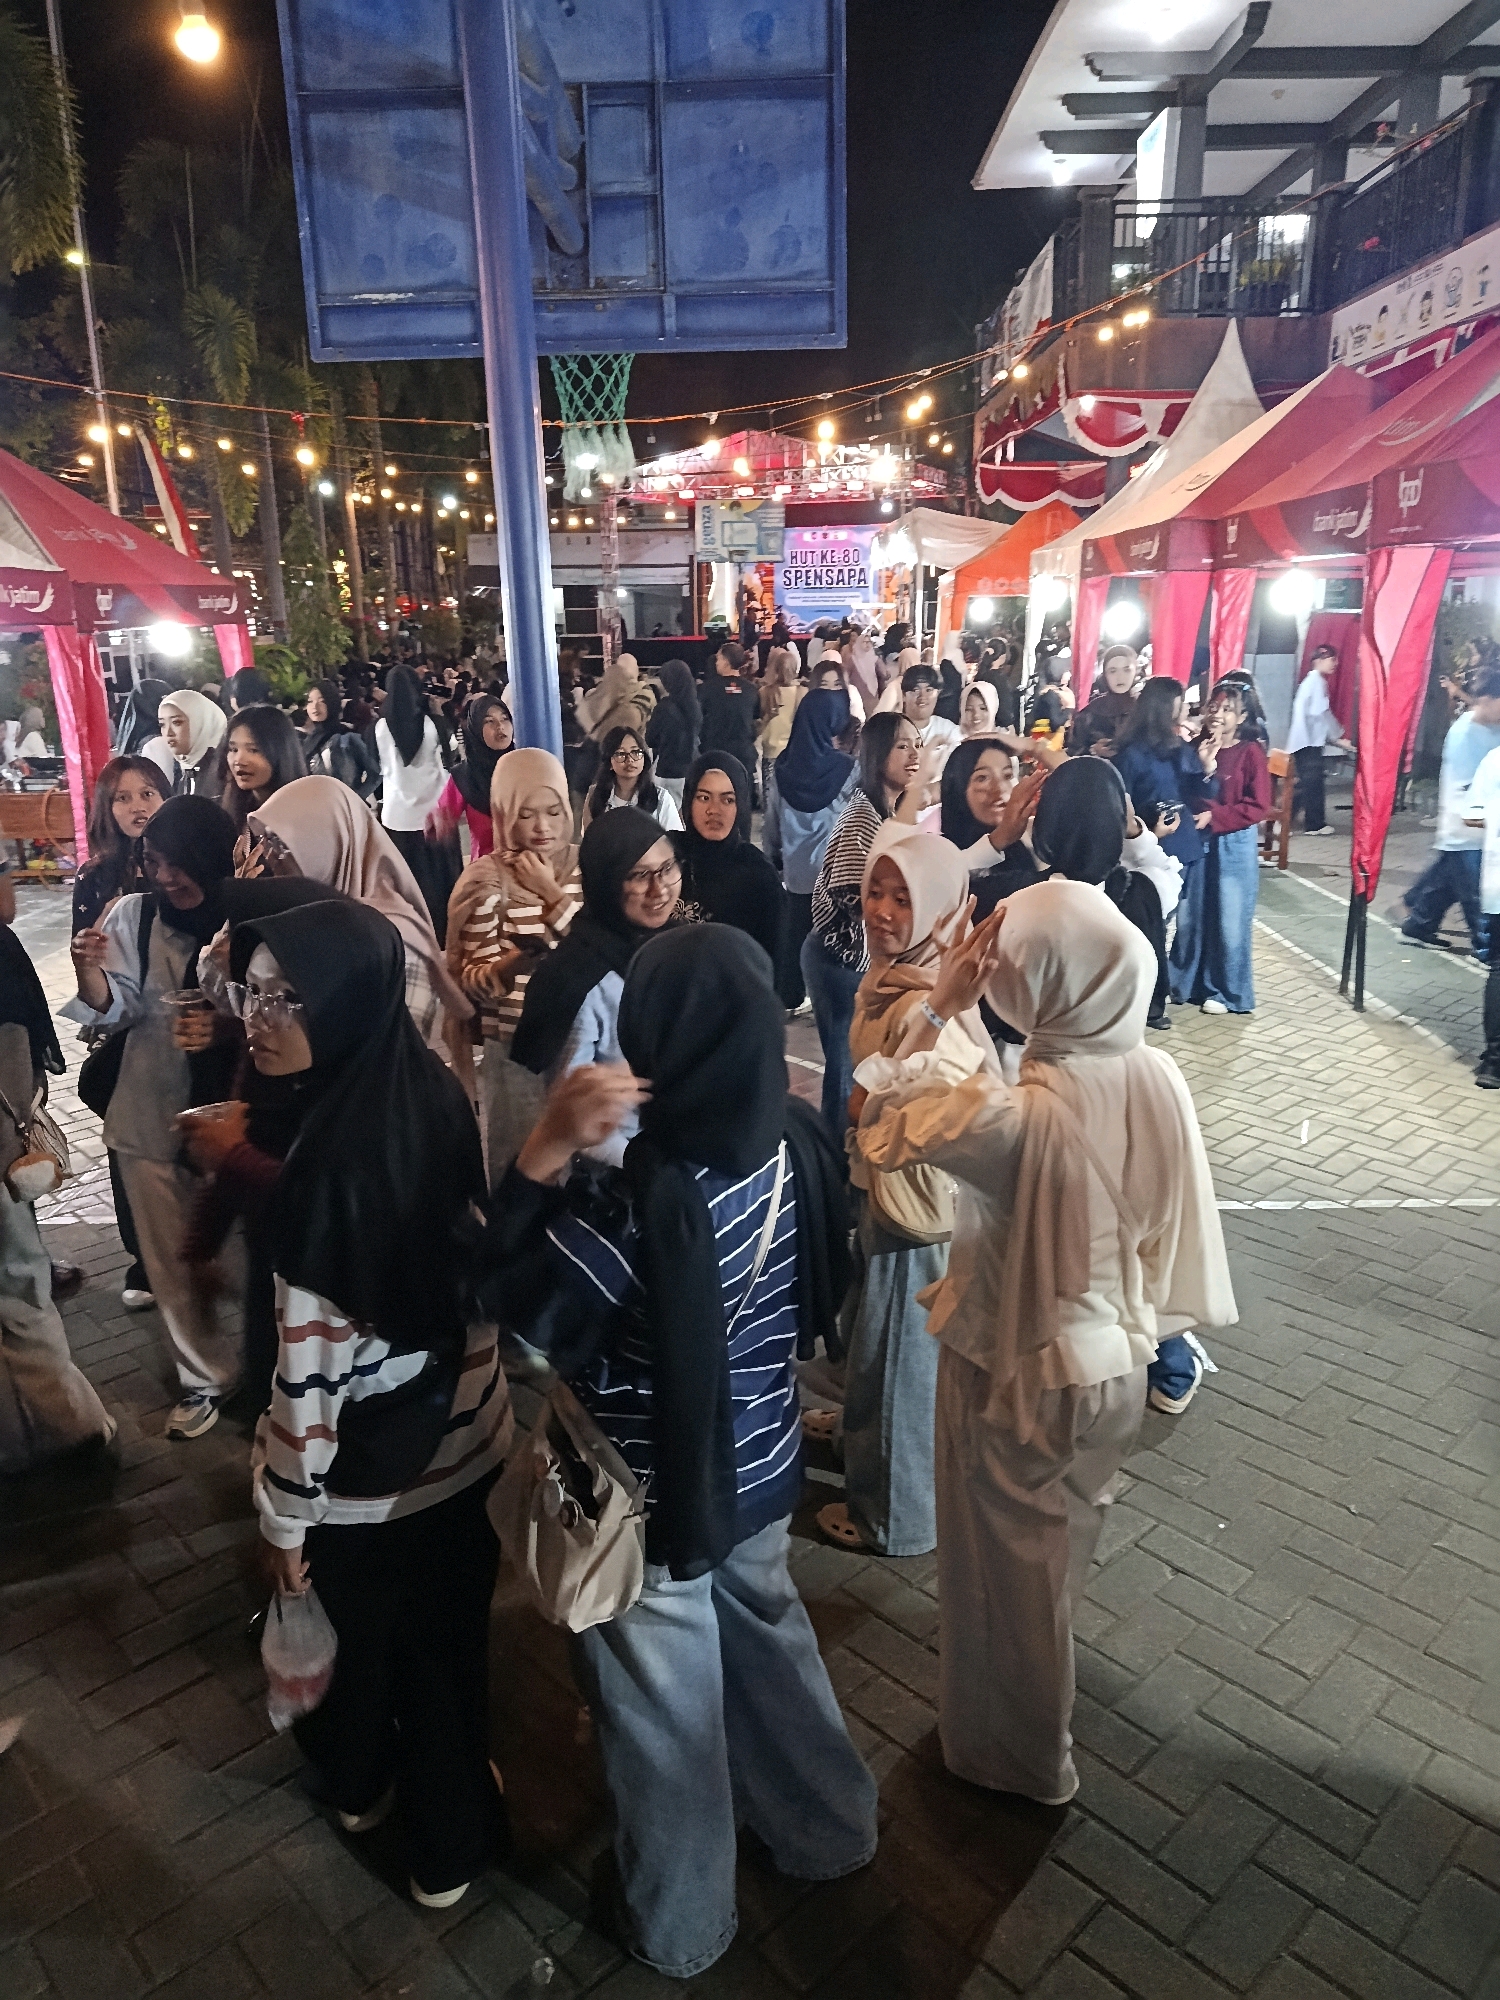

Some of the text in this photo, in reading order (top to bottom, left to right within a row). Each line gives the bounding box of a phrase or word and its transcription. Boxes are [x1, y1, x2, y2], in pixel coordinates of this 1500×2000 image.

[790, 550, 816, 566] HUT
[782, 568, 868, 589] SPENSAPA
[9, 585, 40, 608] jatim
